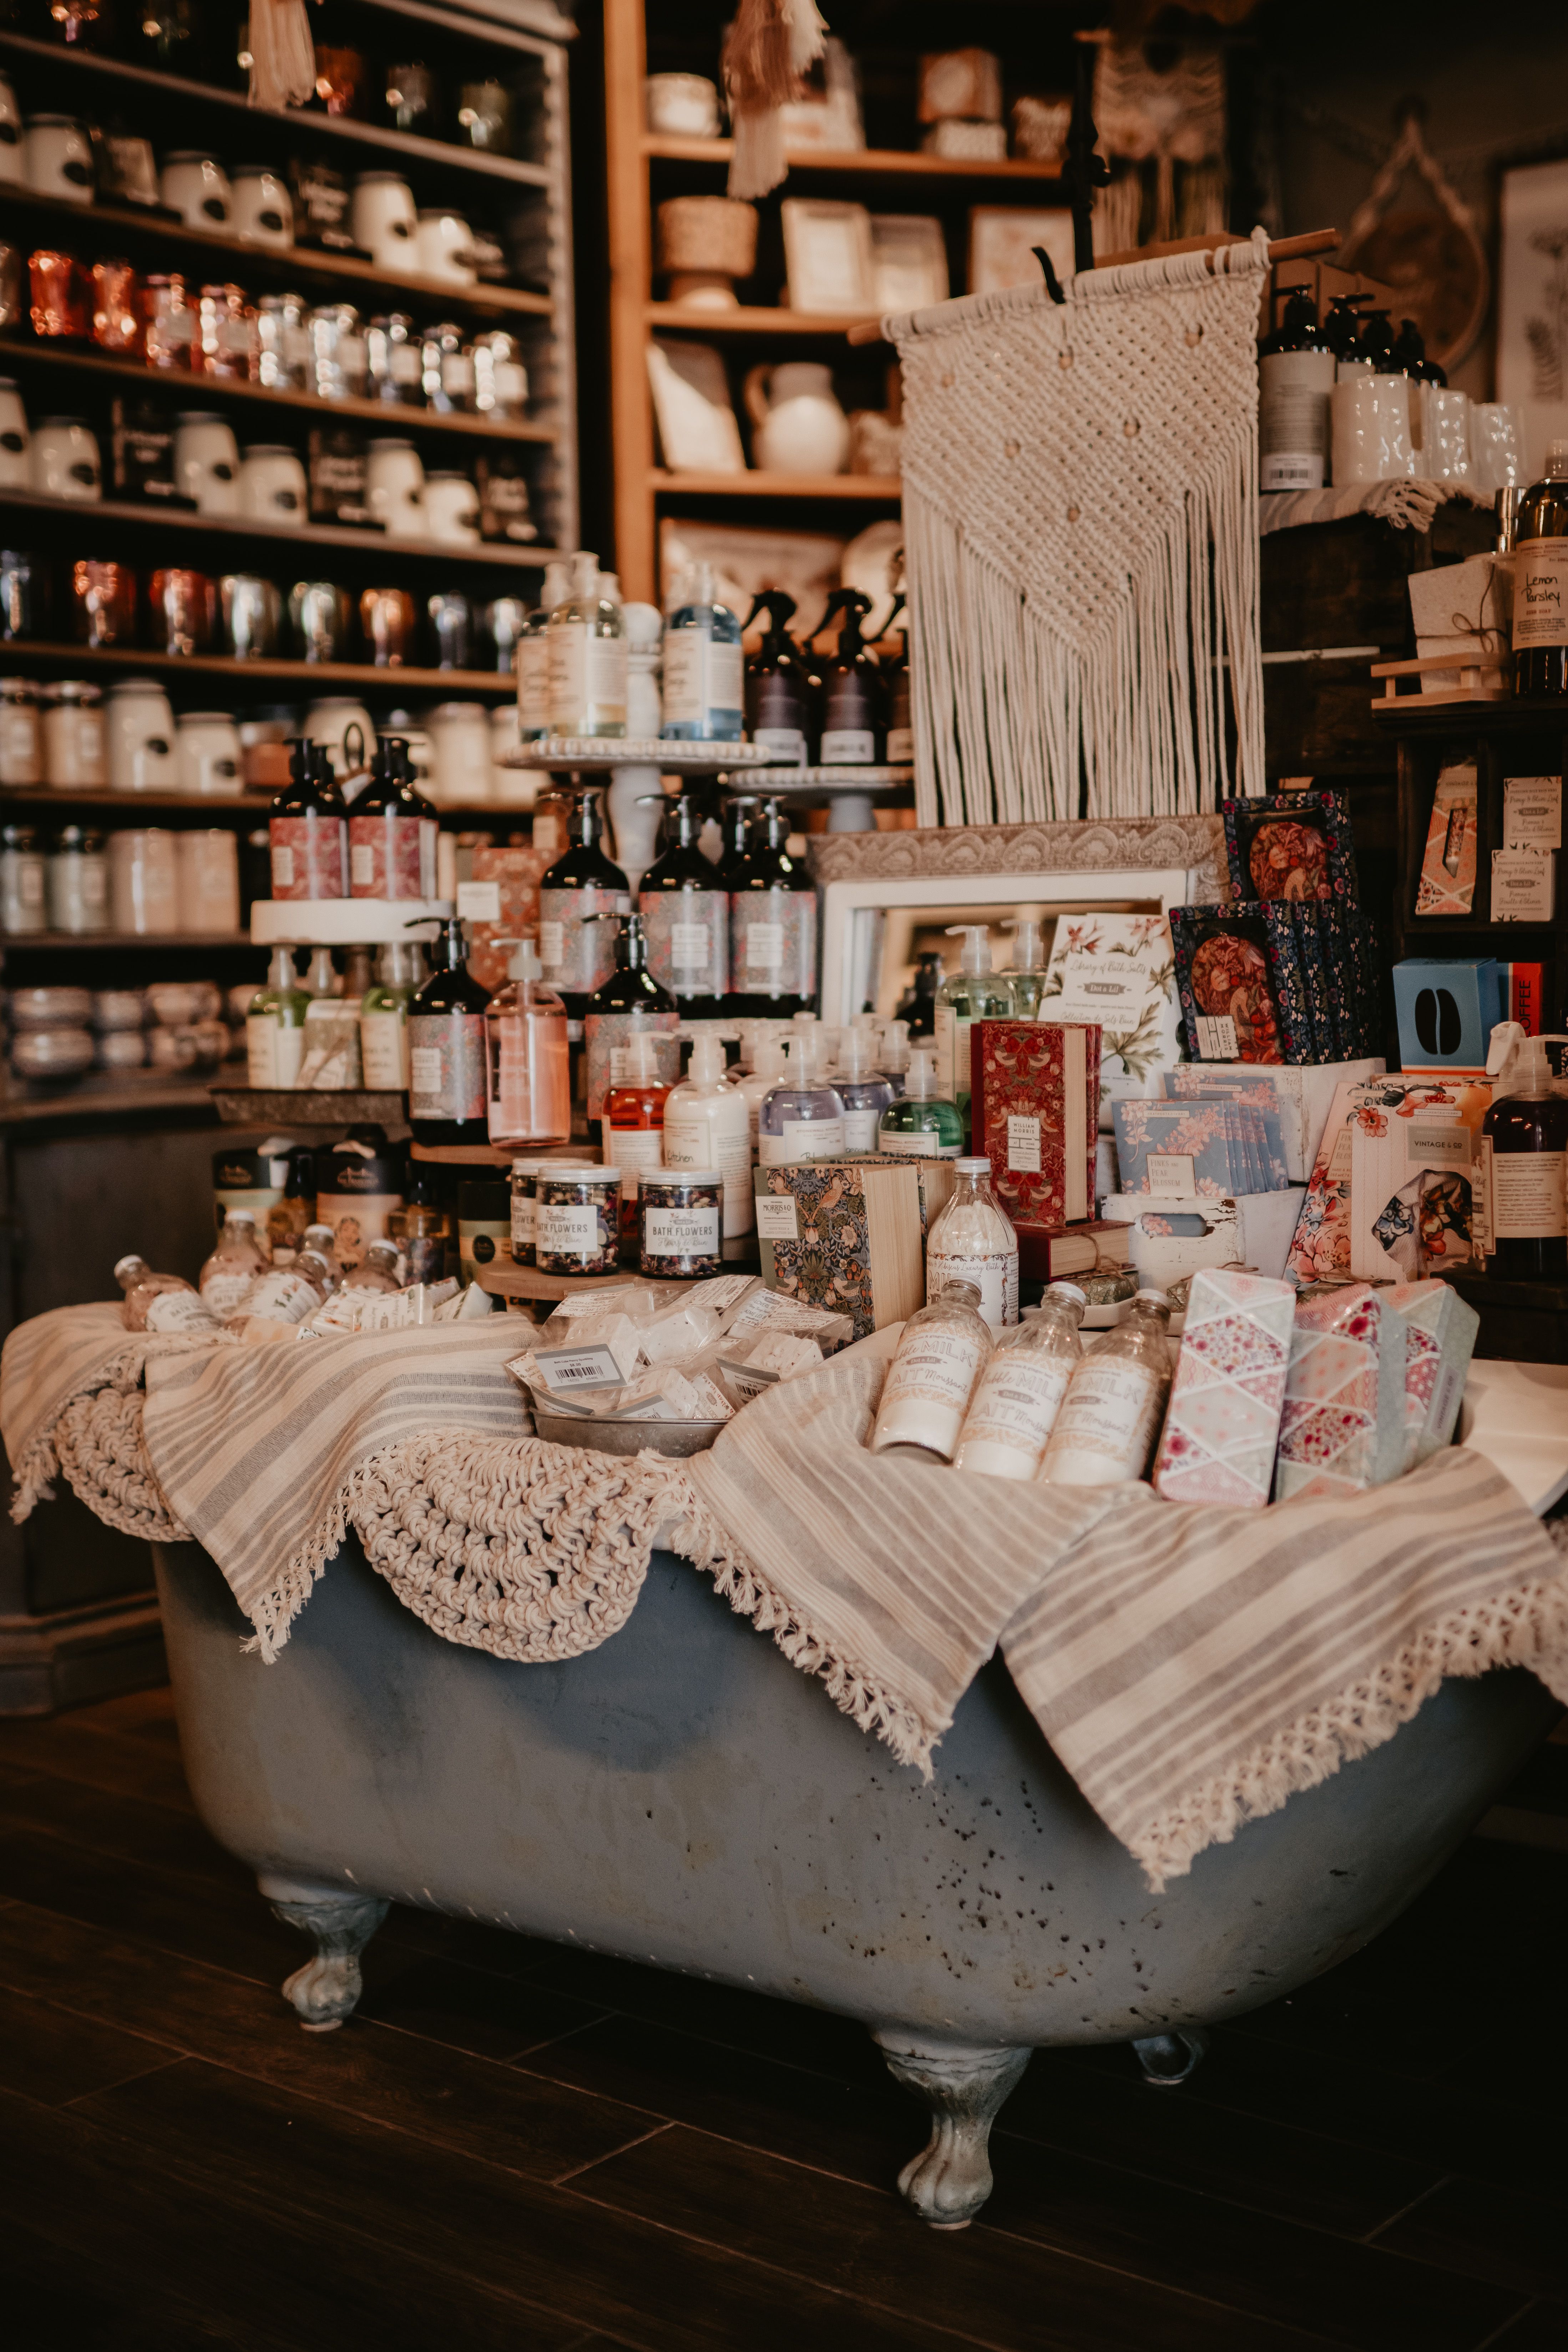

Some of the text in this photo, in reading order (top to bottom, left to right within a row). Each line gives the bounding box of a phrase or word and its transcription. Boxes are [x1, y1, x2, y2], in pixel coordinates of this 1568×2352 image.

[1526, 572, 1557, 588] Lemon
[1521, 586, 1560, 608] Parsley
[1070, 959, 1147, 976] Library of Bath Salts
[1090, 984, 1102, 992] Dot
[1519, 980, 1531, 1037] OFFEE
[1060, 1011, 1091, 1021] Collection
[667, 1150, 694, 1162] Kitchen
[1152, 1168, 1168, 1177] PEAR
[1152, 1178, 1180, 1187] BLOSSOM
[550, 1224, 588, 1233] FLOWERS
[653, 1226, 713, 1236] BATH FLOWERS
[692, 1237, 708, 1247] Bain
[938, 1261, 960, 1271] Hibiscus
[961, 1262, 985, 1274] Luxury
[985, 1262, 1000, 1271] Bath
[893, 1340, 974, 1368] ubble MILK
[925, 1369, 968, 1394] Moussant
[1084, 1377, 1142, 1405] MILK
[1437, 1393, 1450, 1429] VINTAGE
[1015, 1408, 1052, 1435] Moussa
